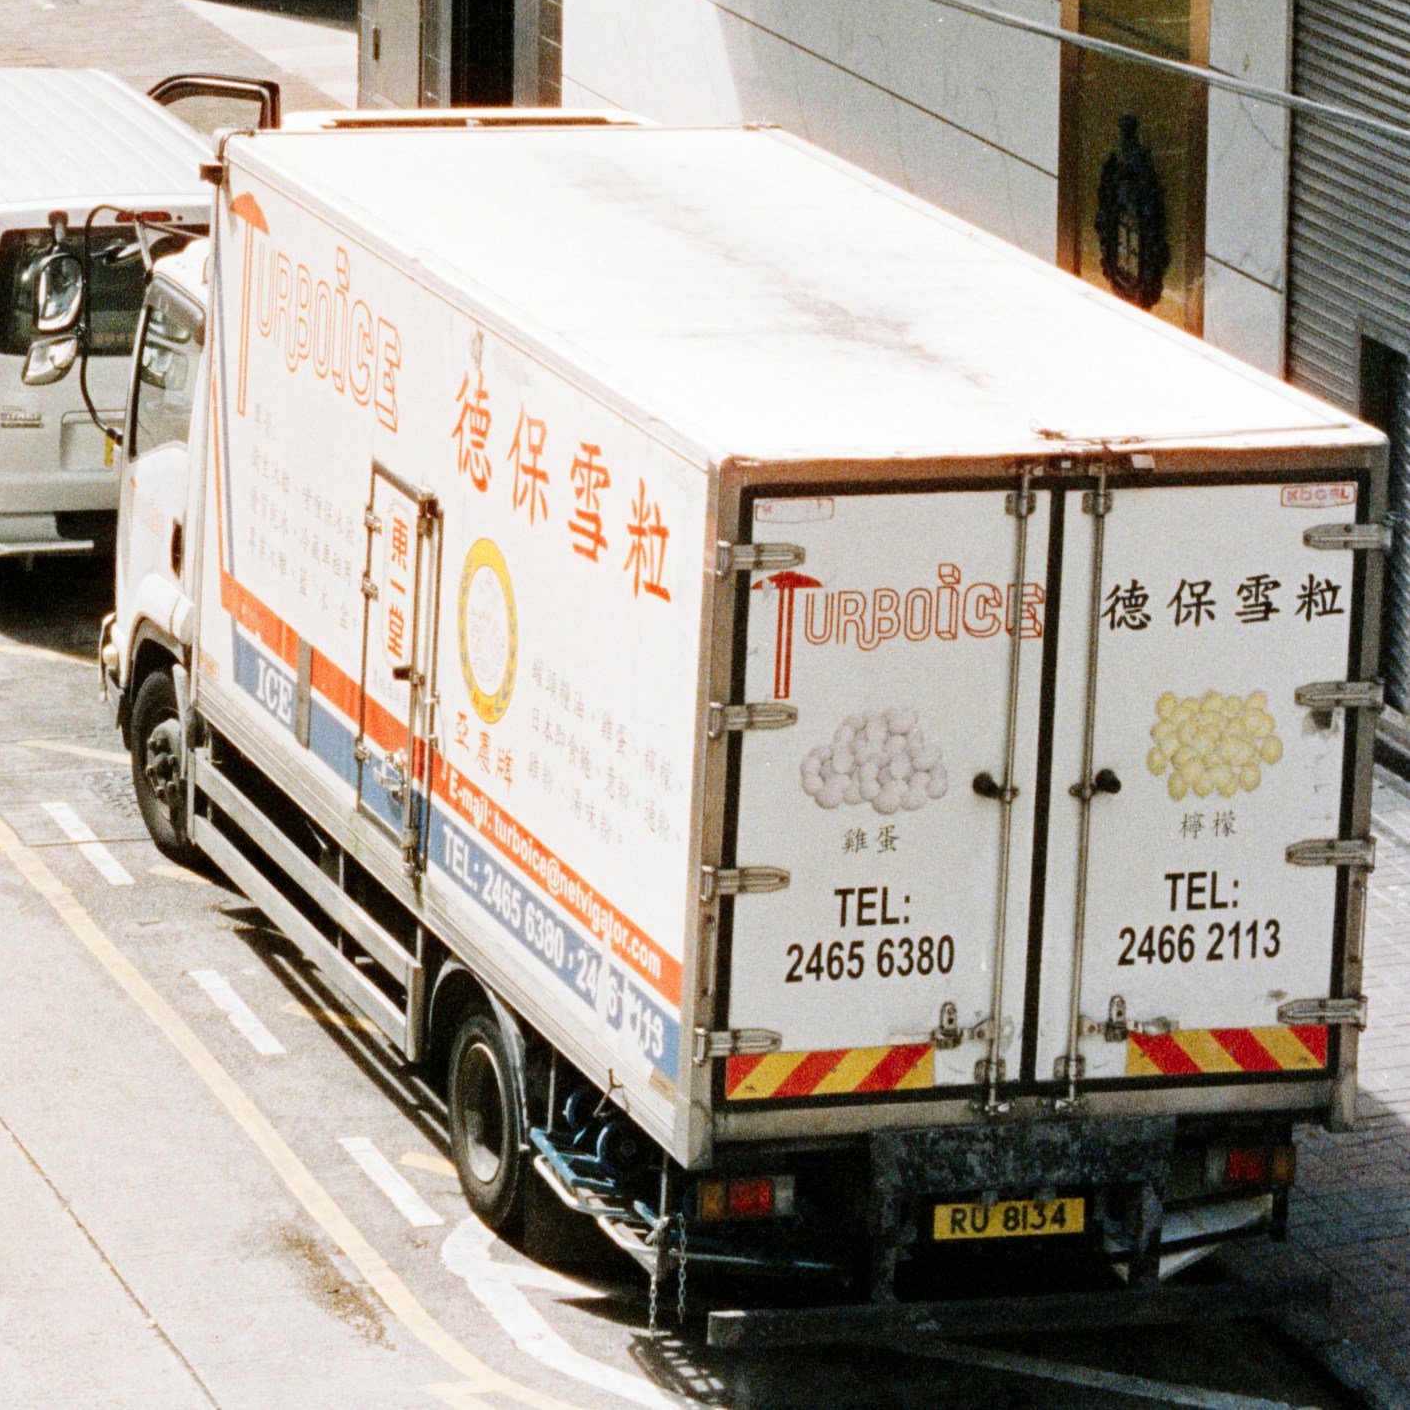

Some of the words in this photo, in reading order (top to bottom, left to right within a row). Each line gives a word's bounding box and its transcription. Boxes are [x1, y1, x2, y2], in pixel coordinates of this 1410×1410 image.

[451, 370, 672, 603] 德保雪粒
[1101, 572, 1346, 632] 德保雪粒
[255, 658, 293, 726] ICE
[842, 825, 902, 856] 雞蛋
[1180, 810, 1238, 840] 檸檬
[448, 768, 493, 831] E-mail:
[494, 814, 662, 980] turboice@netvigator.com
[1164, 872, 1241, 912] TEL:
[442, 823, 481, 889] TEL:
[482, 862, 522, 931] 2465
[577, 943, 622, 1019] 246
[833, 887, 912, 929] TEL:
[785, 941, 866, 985] 2465
[876, 935, 956, 979] 6380
[1118, 924, 1201, 967] 2466
[1206, 919, 1282, 963] 2113
[949, 1205, 990, 1236] RU
[1002, 1200, 1067, 1232] 8134
